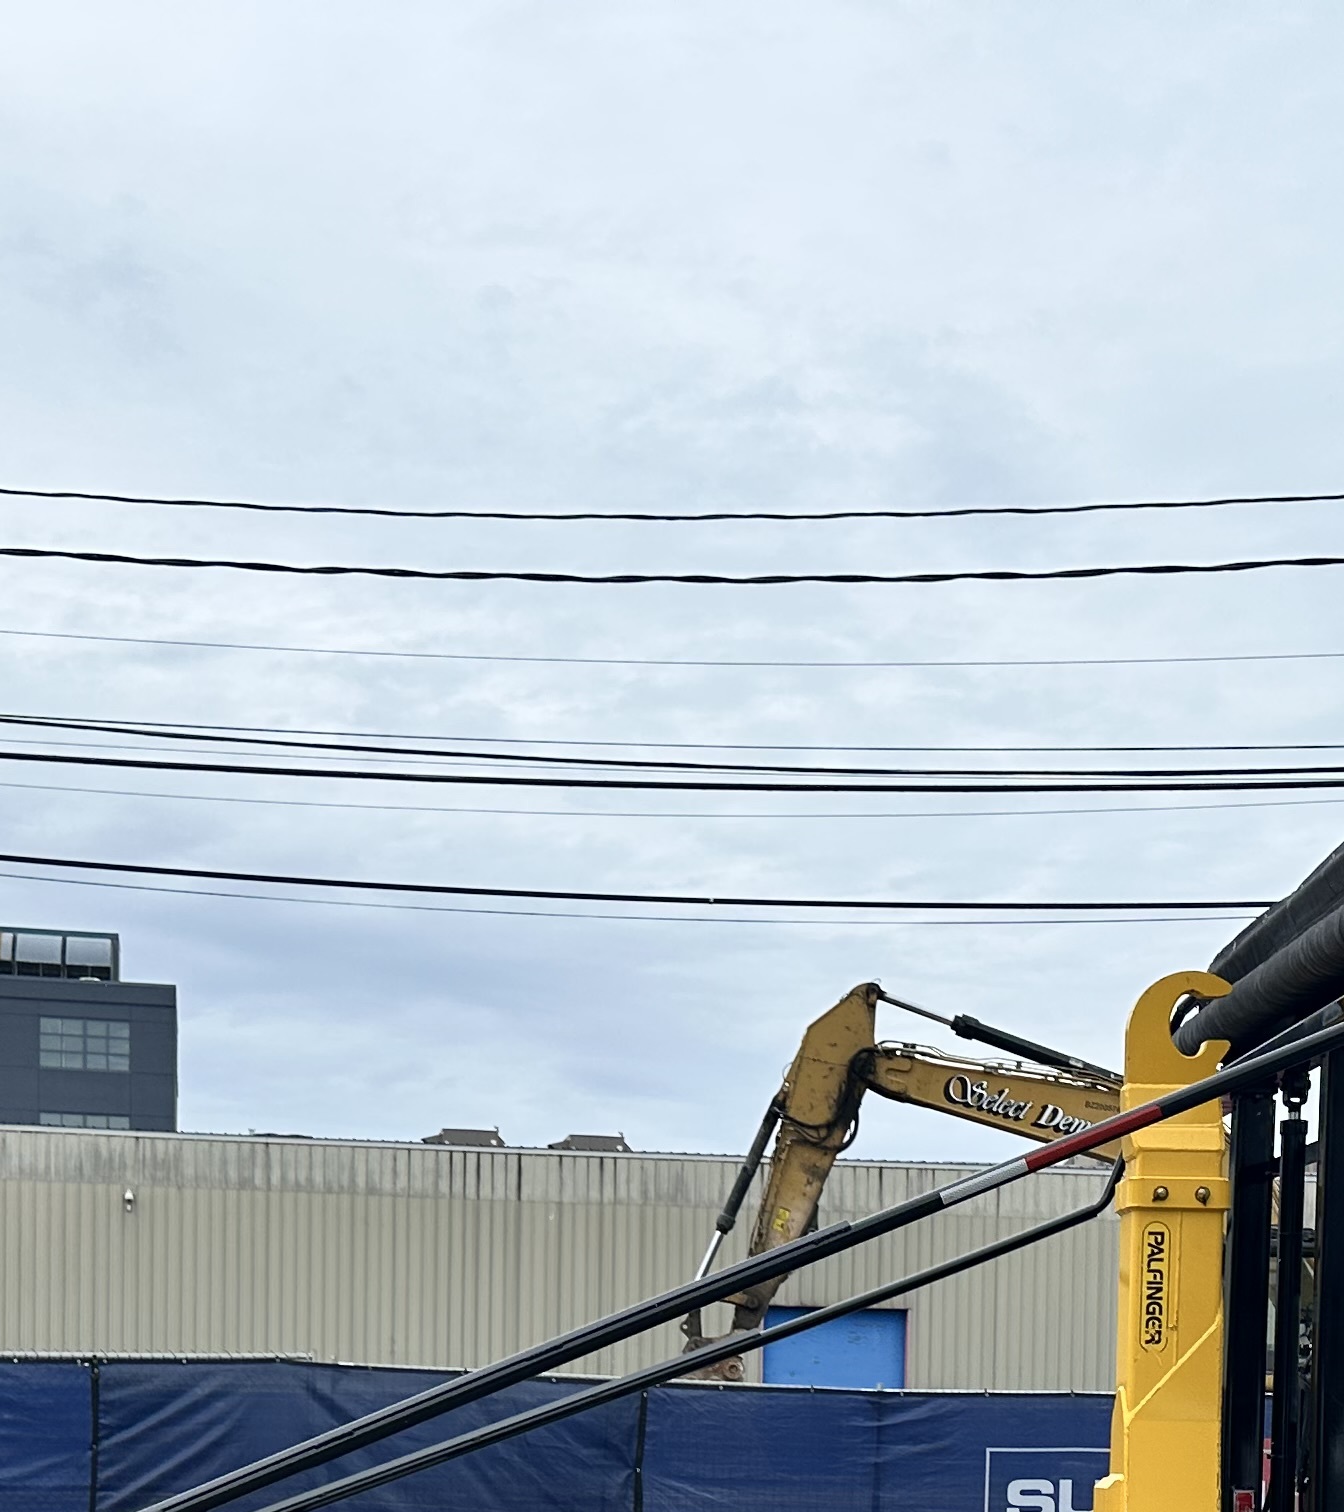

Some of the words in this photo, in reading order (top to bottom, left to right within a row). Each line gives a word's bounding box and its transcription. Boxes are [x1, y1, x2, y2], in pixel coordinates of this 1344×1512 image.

[943, 1074, 1033, 1121] Select
[1031, 1103, 1096, 1136] Dem
[1145, 1231, 1165, 1345] PALFINGER
